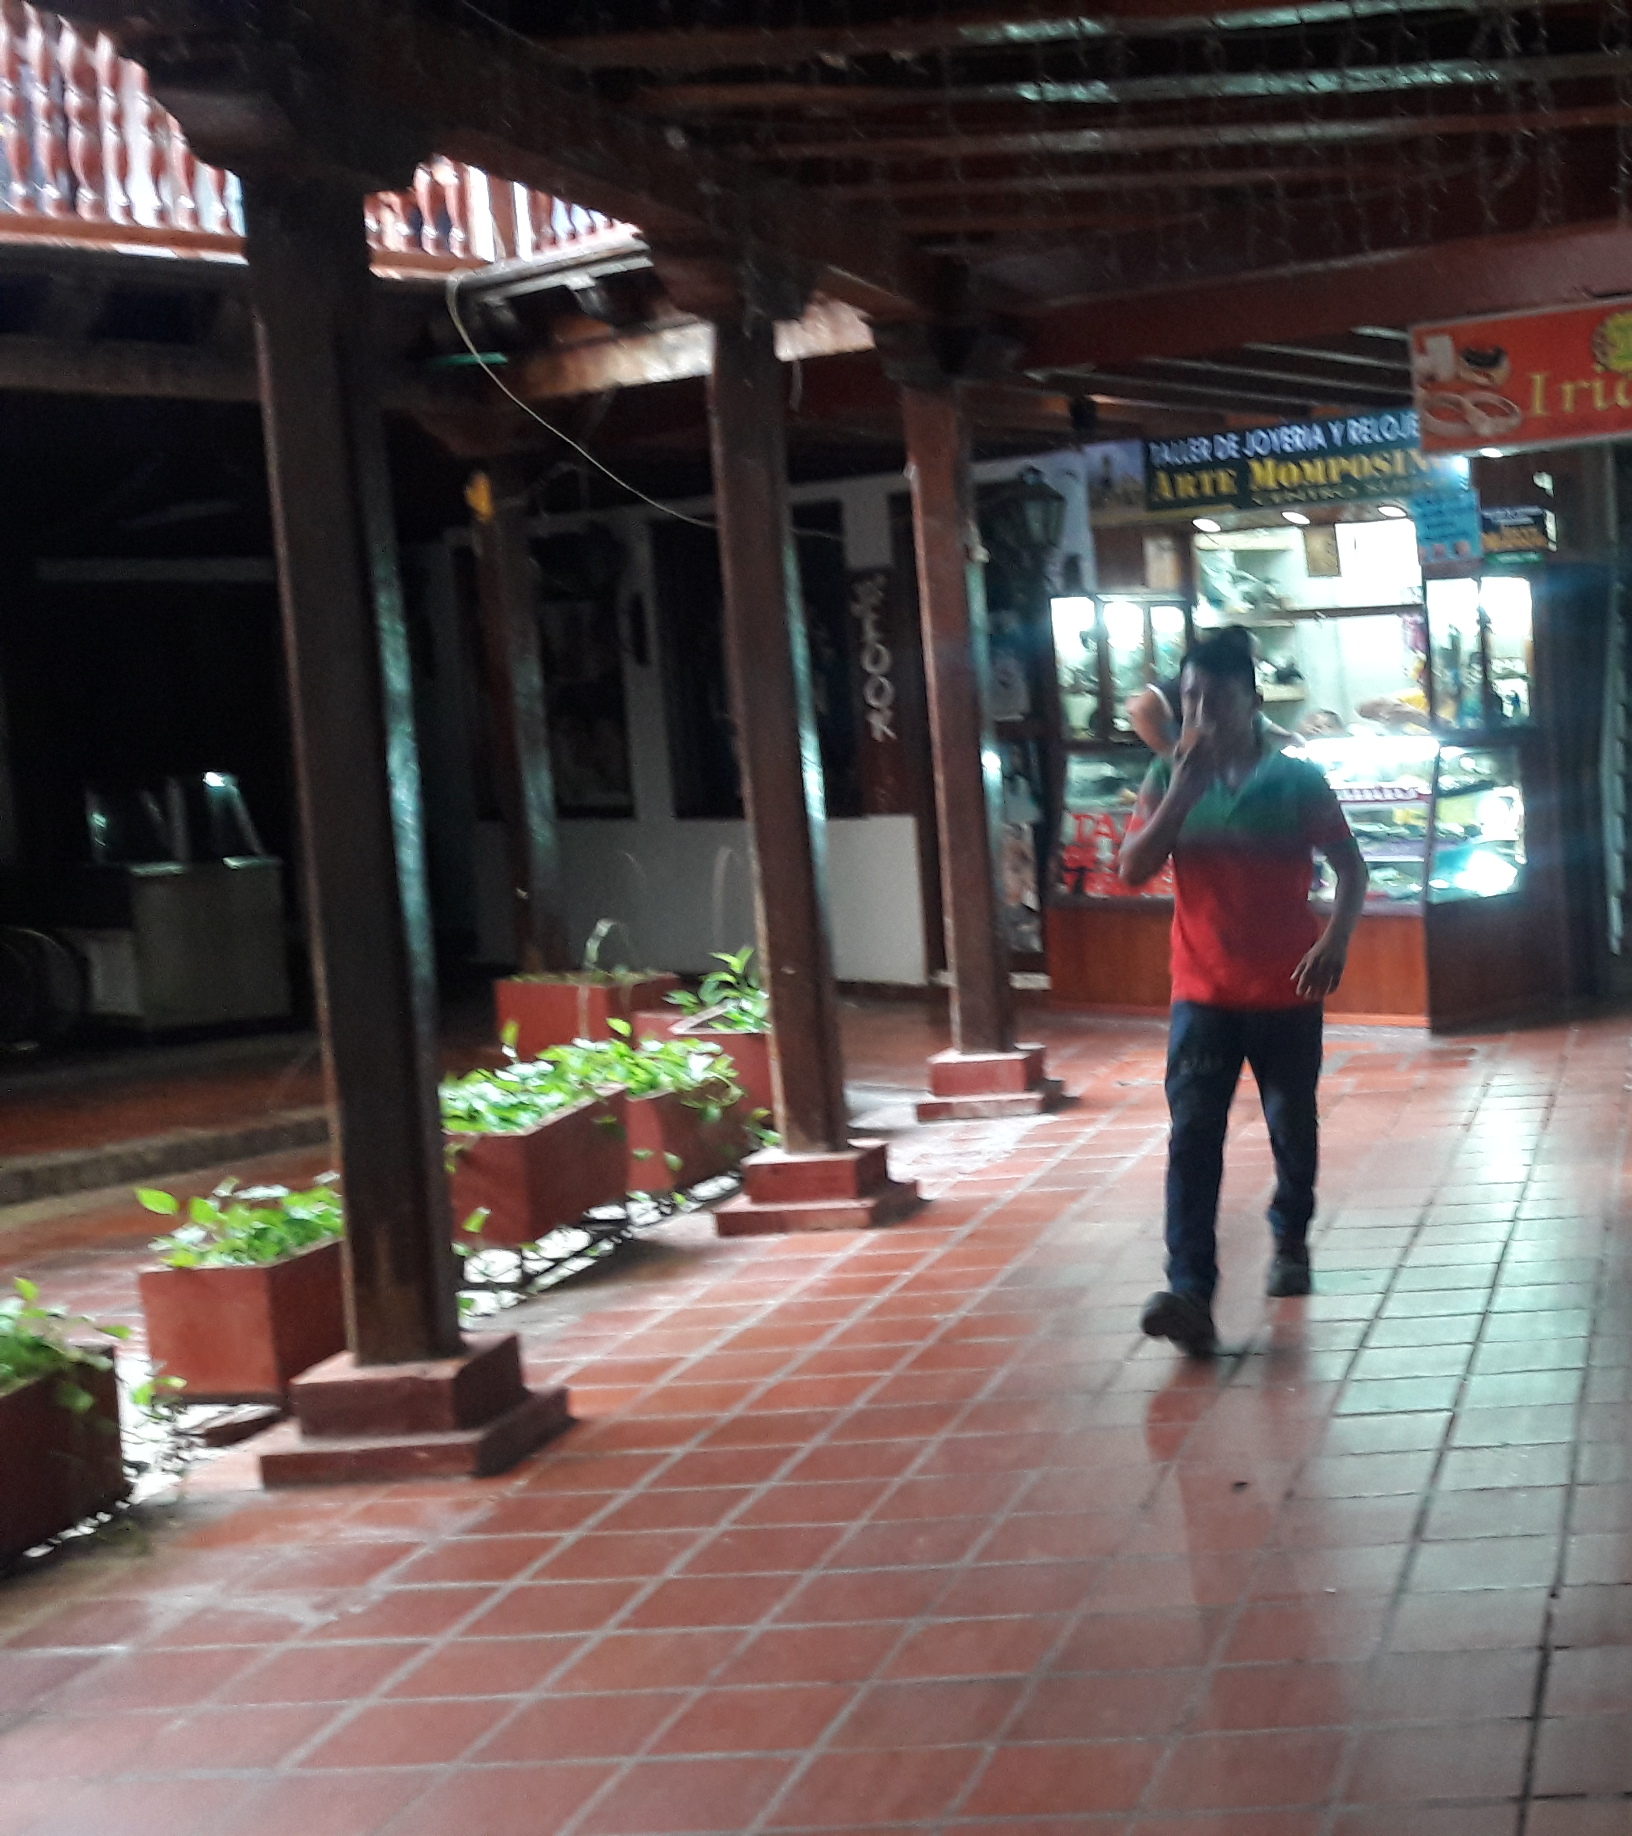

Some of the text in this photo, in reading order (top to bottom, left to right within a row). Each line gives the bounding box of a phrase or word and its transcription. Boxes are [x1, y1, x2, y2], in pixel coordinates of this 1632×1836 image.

[1149, 435, 1214, 467] TALLER
[1213, 431, 1242, 461] DE
[1241, 422, 1328, 457] JOYERIA
[1326, 419, 1346, 448] Y
[1153, 468, 1238, 500] ARTE
